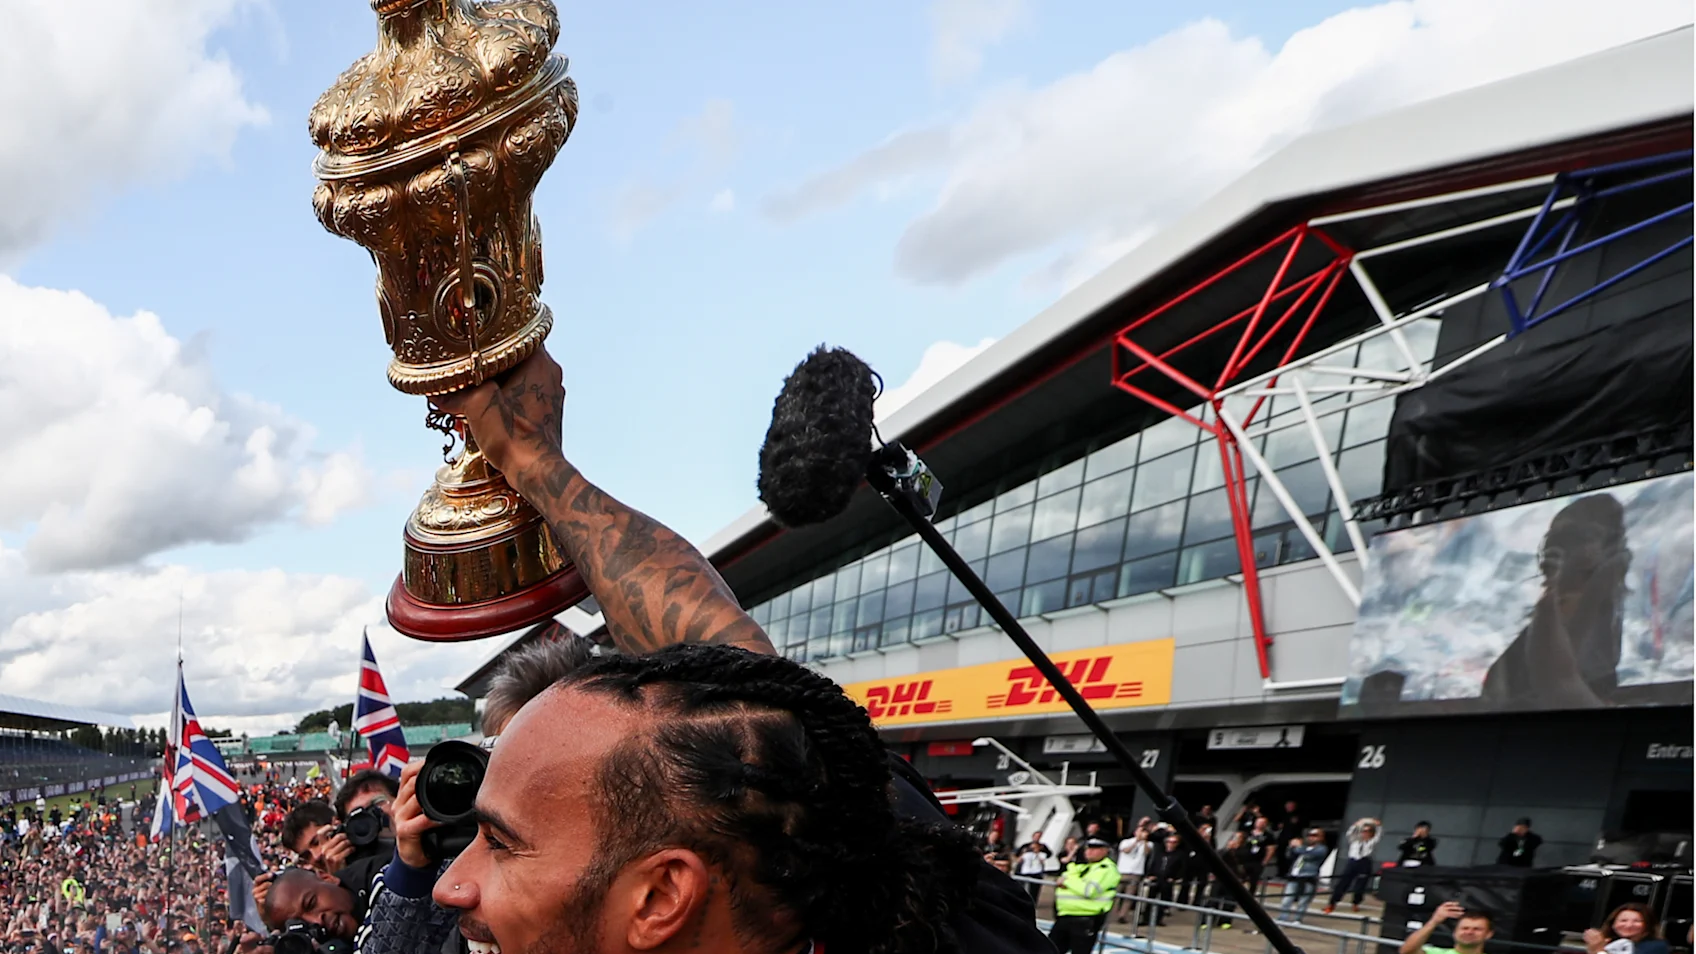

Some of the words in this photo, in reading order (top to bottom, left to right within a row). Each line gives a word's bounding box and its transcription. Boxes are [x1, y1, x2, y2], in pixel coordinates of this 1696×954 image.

[1005, 655, 1119, 707] DHL
[865, 679, 938, 719] DHL
[1141, 749, 1161, 769] 27
[1357, 744, 1387, 769] 26
